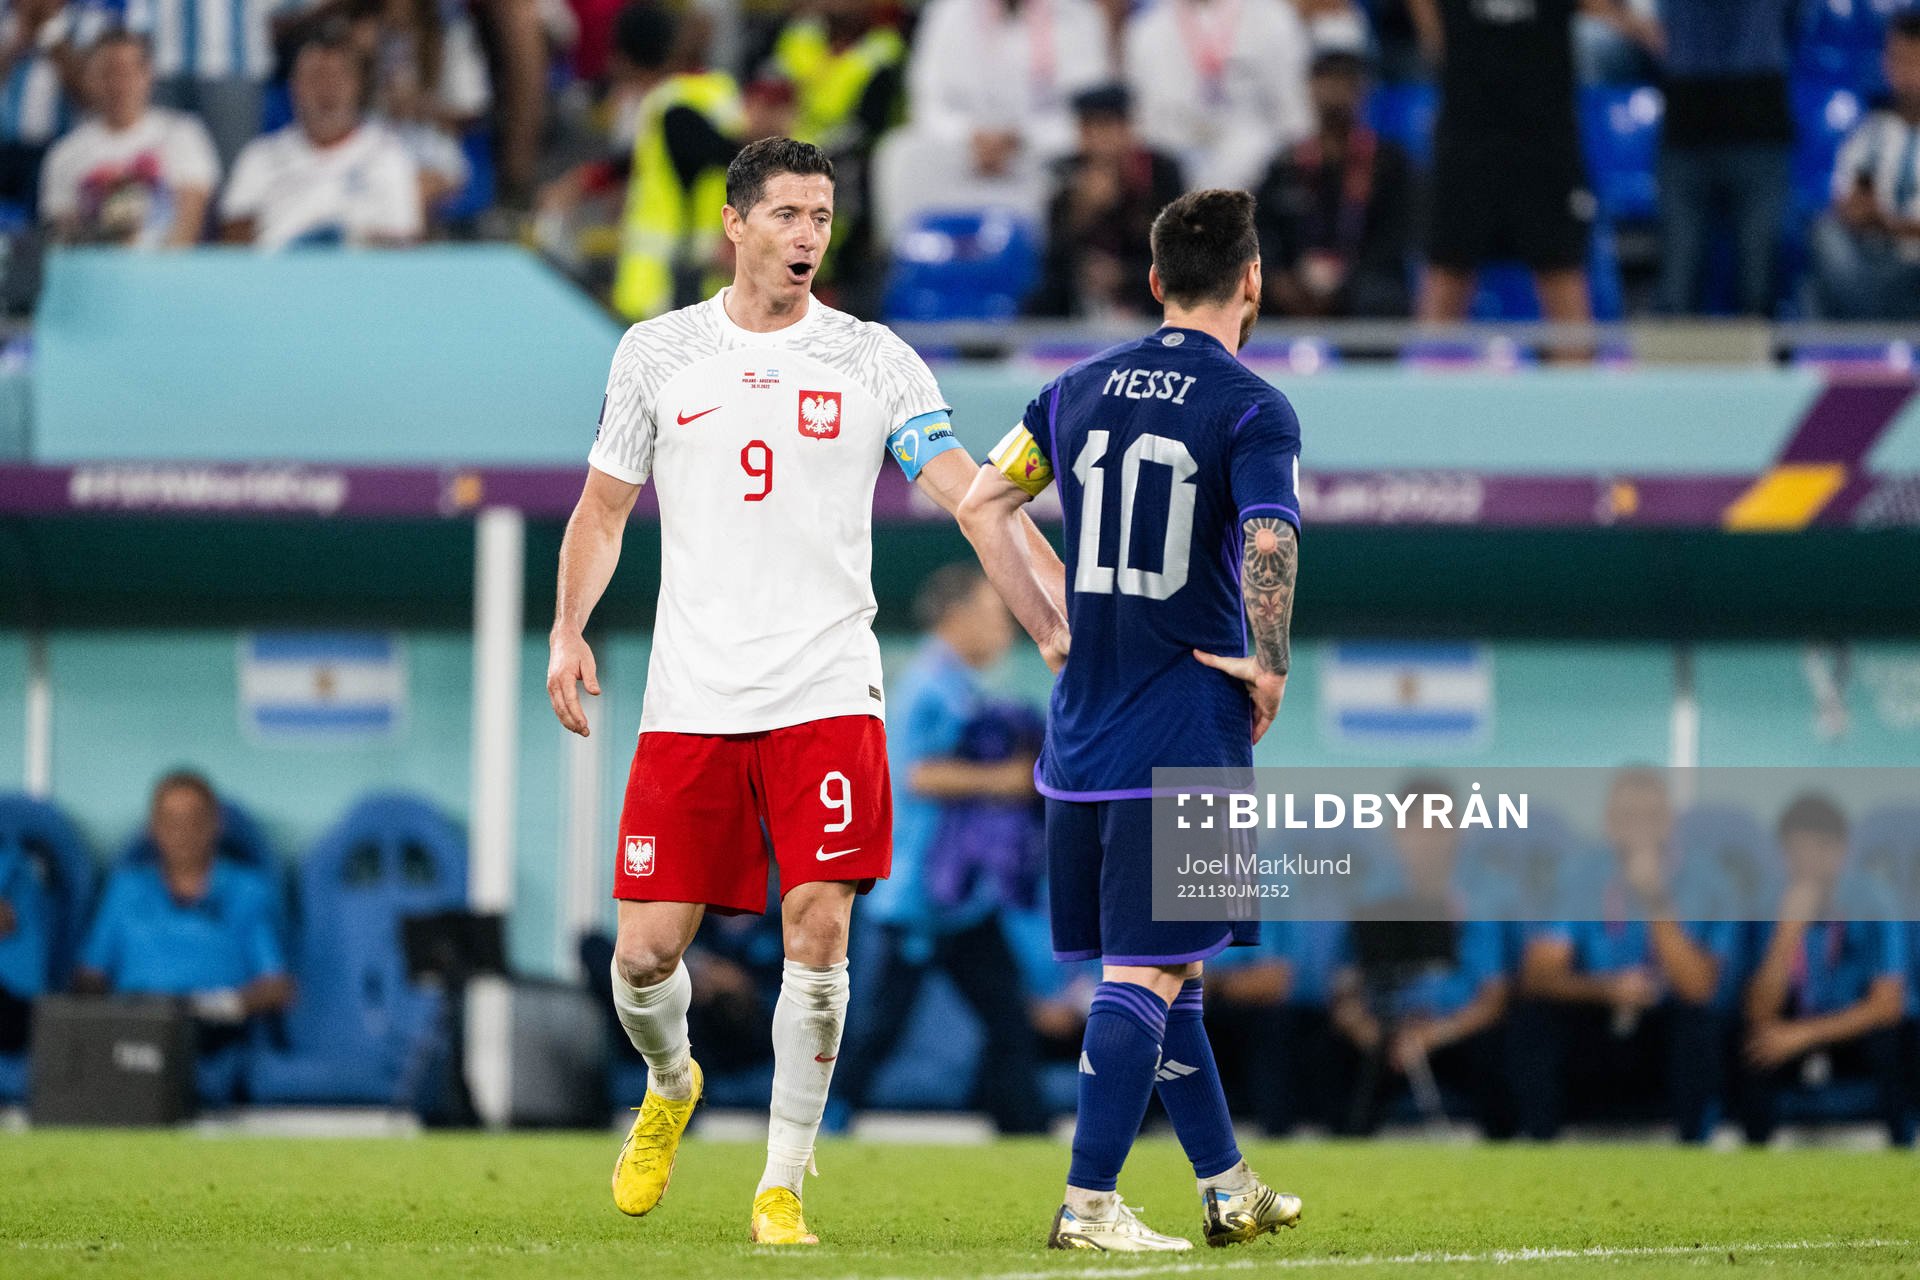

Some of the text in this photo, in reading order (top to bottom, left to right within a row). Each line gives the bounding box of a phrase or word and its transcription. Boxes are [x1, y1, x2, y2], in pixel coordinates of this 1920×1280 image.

[1102, 368, 1197, 405] MESSI
[740, 439, 773, 502] 9
[1072, 430, 1199, 600] 10
[819, 771, 852, 833] 9
